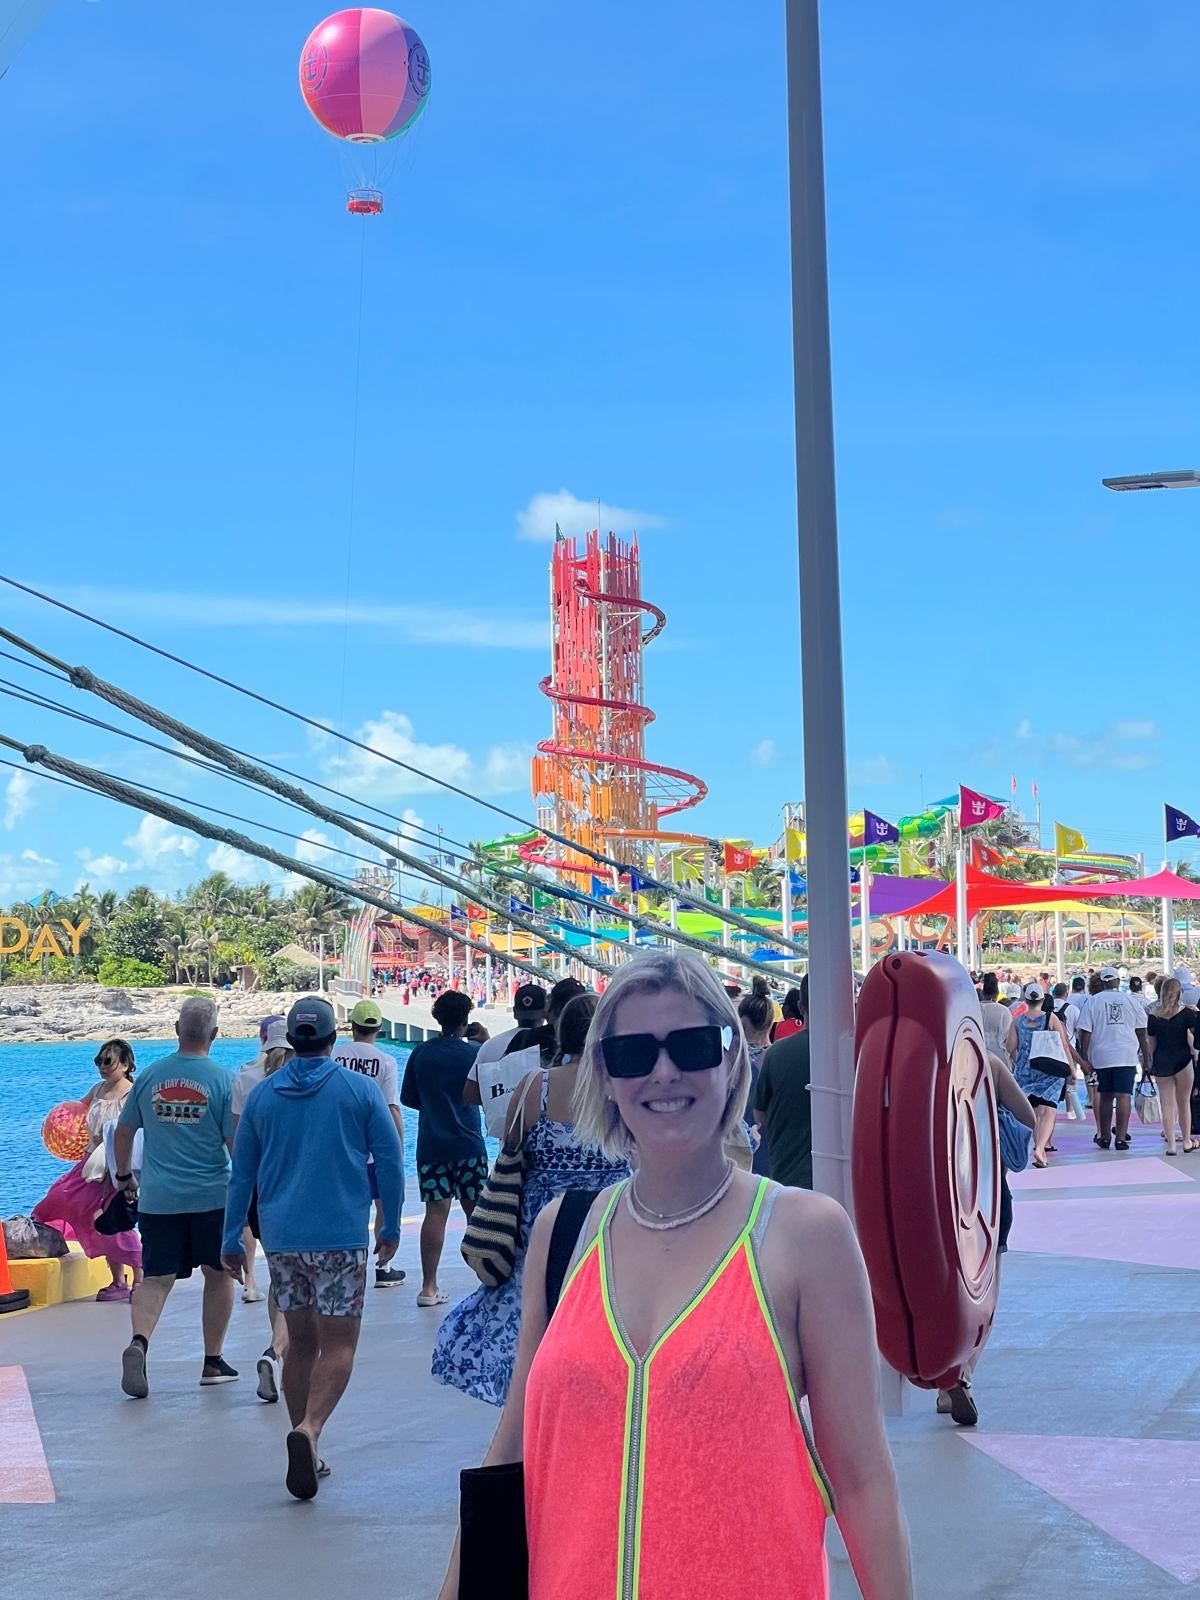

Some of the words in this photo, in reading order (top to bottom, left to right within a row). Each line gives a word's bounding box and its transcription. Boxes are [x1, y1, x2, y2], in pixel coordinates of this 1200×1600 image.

[0, 917, 91, 961] DAY
[164, 1078, 180, 1090] DAY
[180, 1077, 210, 1098] PARKING
